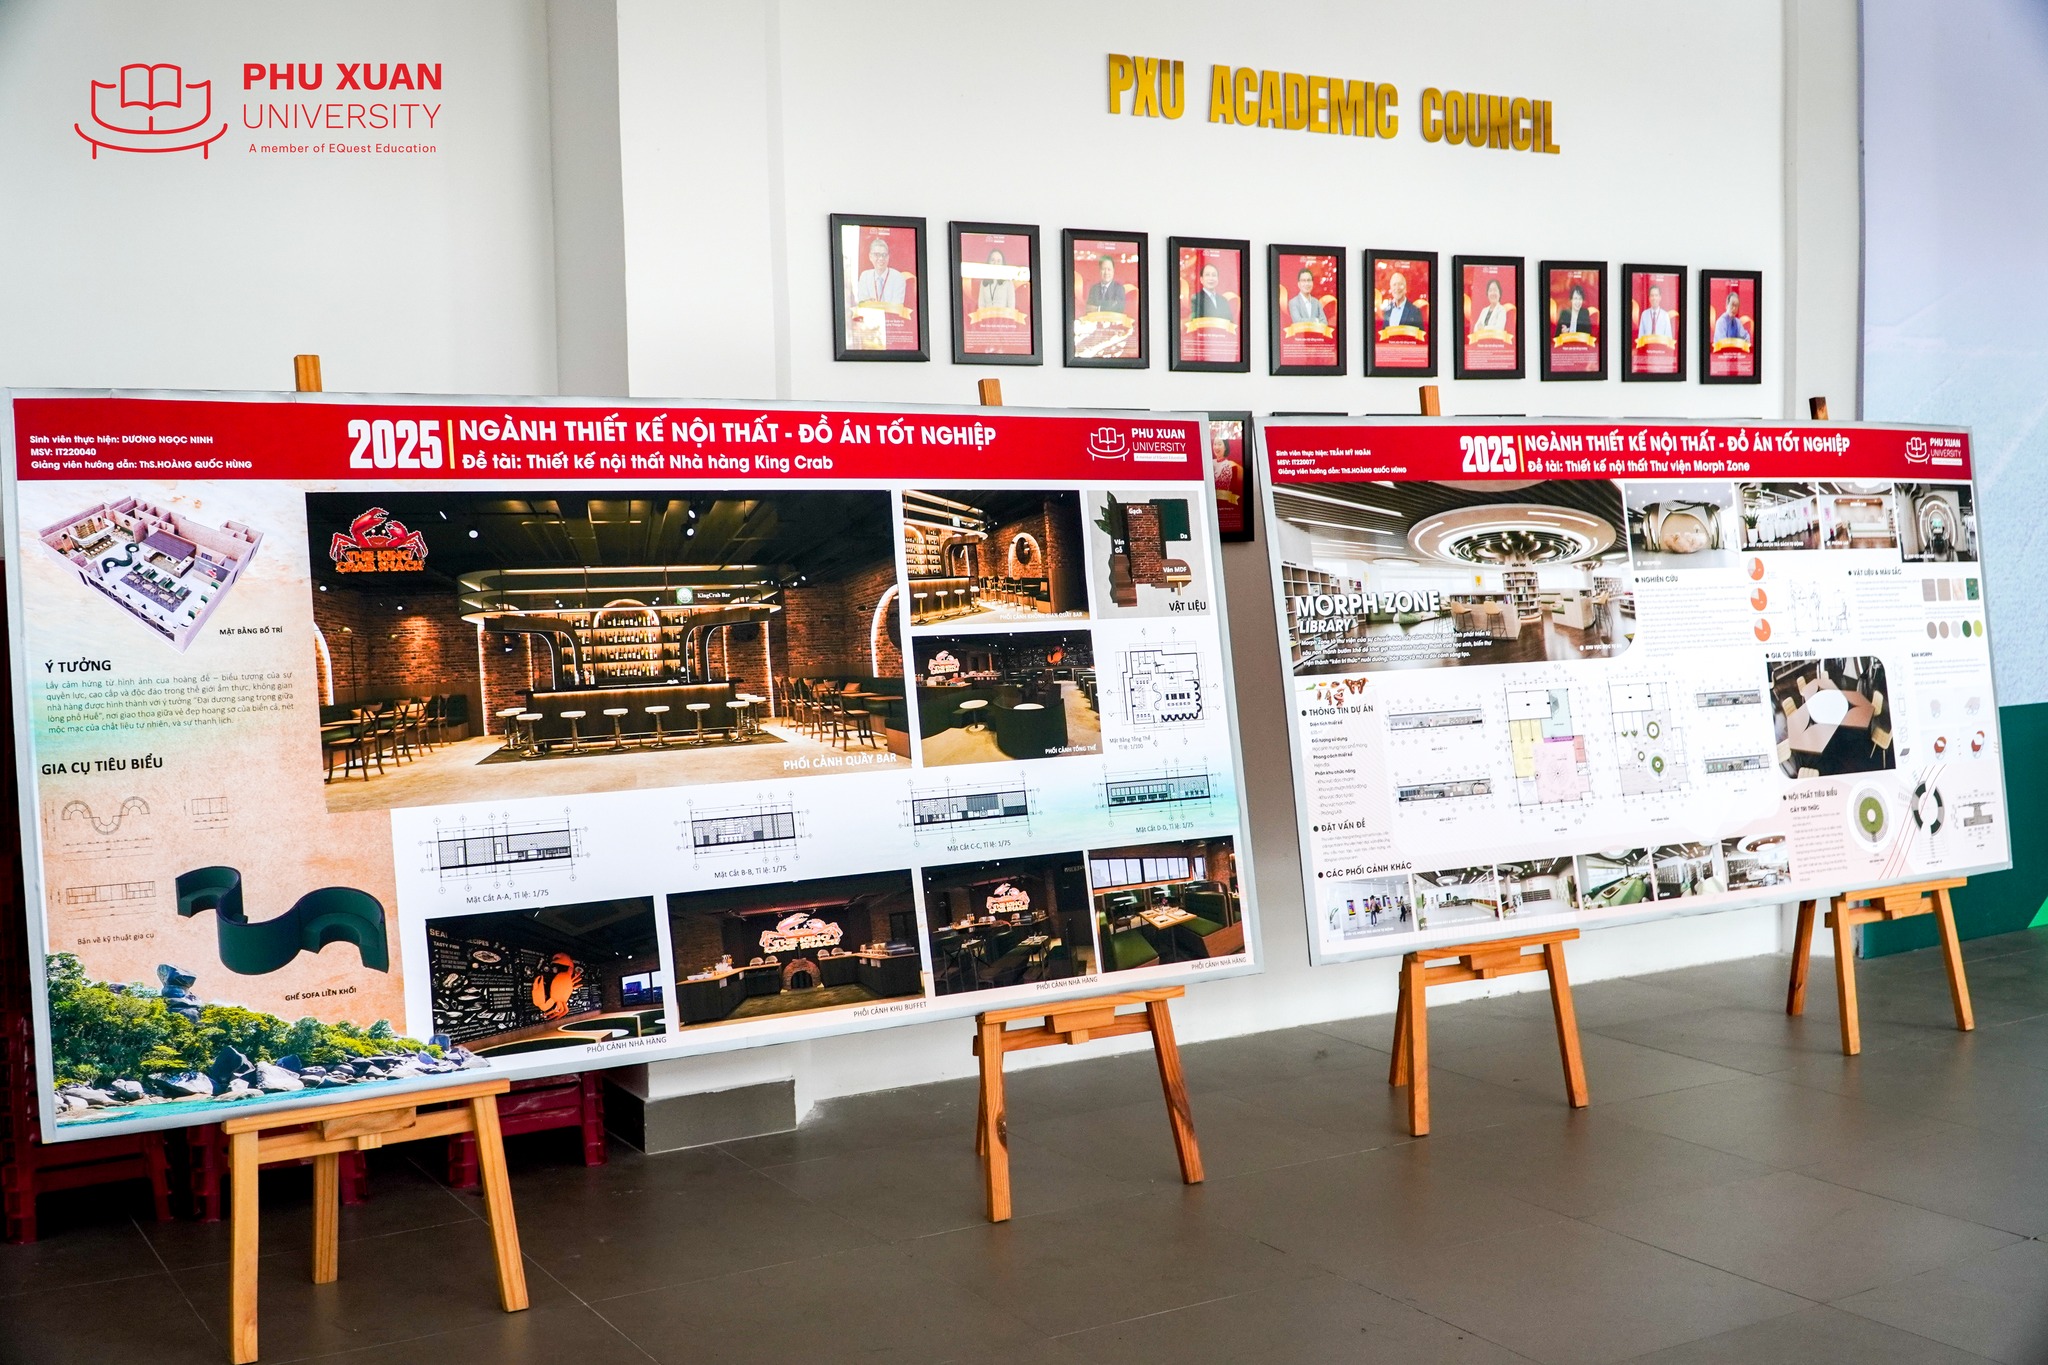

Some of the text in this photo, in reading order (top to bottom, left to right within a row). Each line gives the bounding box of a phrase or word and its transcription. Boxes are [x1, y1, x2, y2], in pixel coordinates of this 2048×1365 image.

[1107, 53, 1560, 155] PXU ACADEMIC COUNCIL
[29, 434, 214, 446] Sinh viên thực hiện: DƯƠNG NGỌC NINH
[459, 414, 556, 442] NGÀNH
[564, 412, 628, 442] THIẾT
[635, 413, 668, 443] KẾ
[671, 417, 716, 448] NỘI
[721, 414, 779, 443] THẤT
[798, 414, 833, 444] ĐỒ
[839, 418, 871, 444] ÁN
[876, 417, 915, 445] TỐT
[921, 422, 997, 451] NGHIỆP
[1131, 427, 1186, 440] PHU XUAN
[347, 420, 442, 469] 2025
[1132, 441, 1187, 452] UNIVERSITY
[1524, 430, 1583, 452] NGÀNH
[1585, 429, 1625, 452] THIẾT
[1628, 429, 1648, 452] KẾ
[1650, 431, 1678, 456] NỘI
[1680, 429, 1716, 452] THẤT
[1727, 428, 1750, 452] ĐỒ
[1752, 431, 1773, 453] ÁN
[1775, 430, 1800, 453] TỐT
[1803, 433, 1851, 457] NGHIỆP
[1929, 437, 1961, 448] PHU XUAN
[30, 448, 97, 456] MSV: IT220040
[1459, 435, 1518, 474] 2025
[1930, 448, 1962, 458] UNIVERSITY
[62, 460, 83, 469] viên
[139, 458, 193, 469] ThS.HOÀNG
[225, 458, 253, 469] HÙNG
[461, 449, 834, 473] Đề tài: Thiết kế nội thất Nhà hàng King Crab
[1527, 457, 1750, 475] Đề tài: Thiết kế nội thất Thư viện Morph Zone
[1168, 599, 1207, 613] VẬT LIỆU
[1294, 589, 1442, 618] MORPH ZONE
[219, 627, 236, 637] MẶT
[259, 625, 270, 634] BỐ
[271, 625, 283, 633] TRÍ
[1299, 617, 1354, 635] LIBRARY
[44, 656, 112, 673] Ý TƯỞNG
[1308, 704, 1374, 717] THÔNG TIN DỰ ÁN
[41, 753, 164, 776] GIA CỤ TIÊU BIỂU
[783, 751, 897, 770] PHỐI CẢNH QUẦY BAR
[1325, 860, 1413, 878] CÁC PHỐI CẢNH KHÁC
[466, 895, 481, 905] Mặt
[482, 893, 495, 904] Cắt
[496, 893, 512, 901] A-A,
[521, 889, 531, 900] lệ:
[532, 888, 549, 898] 1/75
[285, 991, 300, 1001] GHẾ
[301, 991, 320, 1000] SOFA
[338, 986, 357, 995] KHỐI
[870, 1006, 889, 1016] CẢNH
[889, 1004, 903, 1012] KHU
[904, 1001, 927, 1010] BUFFET
[628, 1038, 645, 1048] NHÀ
[645, 1036, 667, 1045] HÀNG
